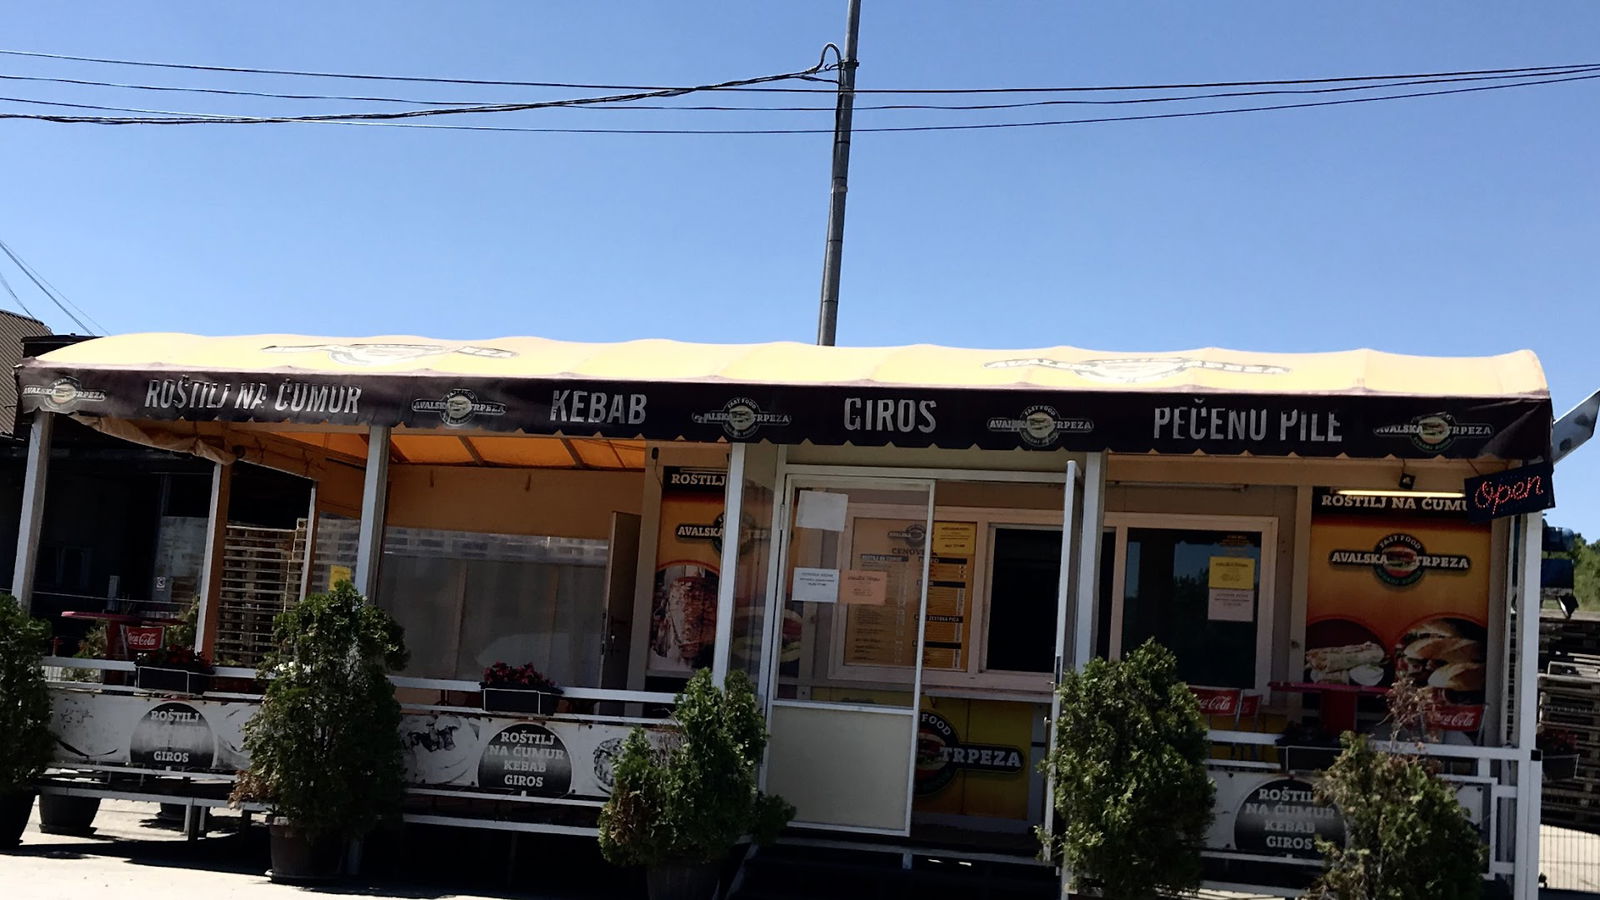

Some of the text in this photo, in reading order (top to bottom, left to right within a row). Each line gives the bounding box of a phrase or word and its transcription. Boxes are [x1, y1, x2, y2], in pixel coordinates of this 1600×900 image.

[144, 374, 232, 408] ROŠTILJ
[234, 382, 266, 409] NA
[550, 390, 647, 424] KEBAB
[728, 398, 757, 410] FAST FOOD
[1024, 405, 1040, 416] FAST
[753, 414, 789, 422] TRPEZA
[844, 398, 937, 433] GIROS
[1153, 398, 1342, 442] PEČENU PILE
[1053, 421, 1091, 429] TRPEZA
[1376, 425, 1491, 435] AVALSKA TRPEZA
[1474, 475, 1544, 514] Open
[1391, 496, 1416, 509] NA
[677, 526, 723, 537] AVALSKA
[1379, 535, 1421, 550] FAST FOOD
[1331, 552, 1469, 568] AVALSKA TRPEZA
[150, 708, 200, 722] ROŠTILJ
[920, 713, 952, 736] FOOD
[500, 729, 556, 745] ROŠTILJ
[153, 750, 189, 763] GIROS
[488, 744, 564, 760] NA ĆUMUR
[939, 747, 1022, 767] TRPEZA
[504, 760, 547, 772] KEBAB
[504, 774, 545, 787] GIROS
[1258, 786, 1313, 802] ROŠTIL
[1244, 801, 1336, 819] NA ĆUMUR
[1263, 820, 1316, 833] KEBAB
[1265, 835, 1313, 850] GIROS
